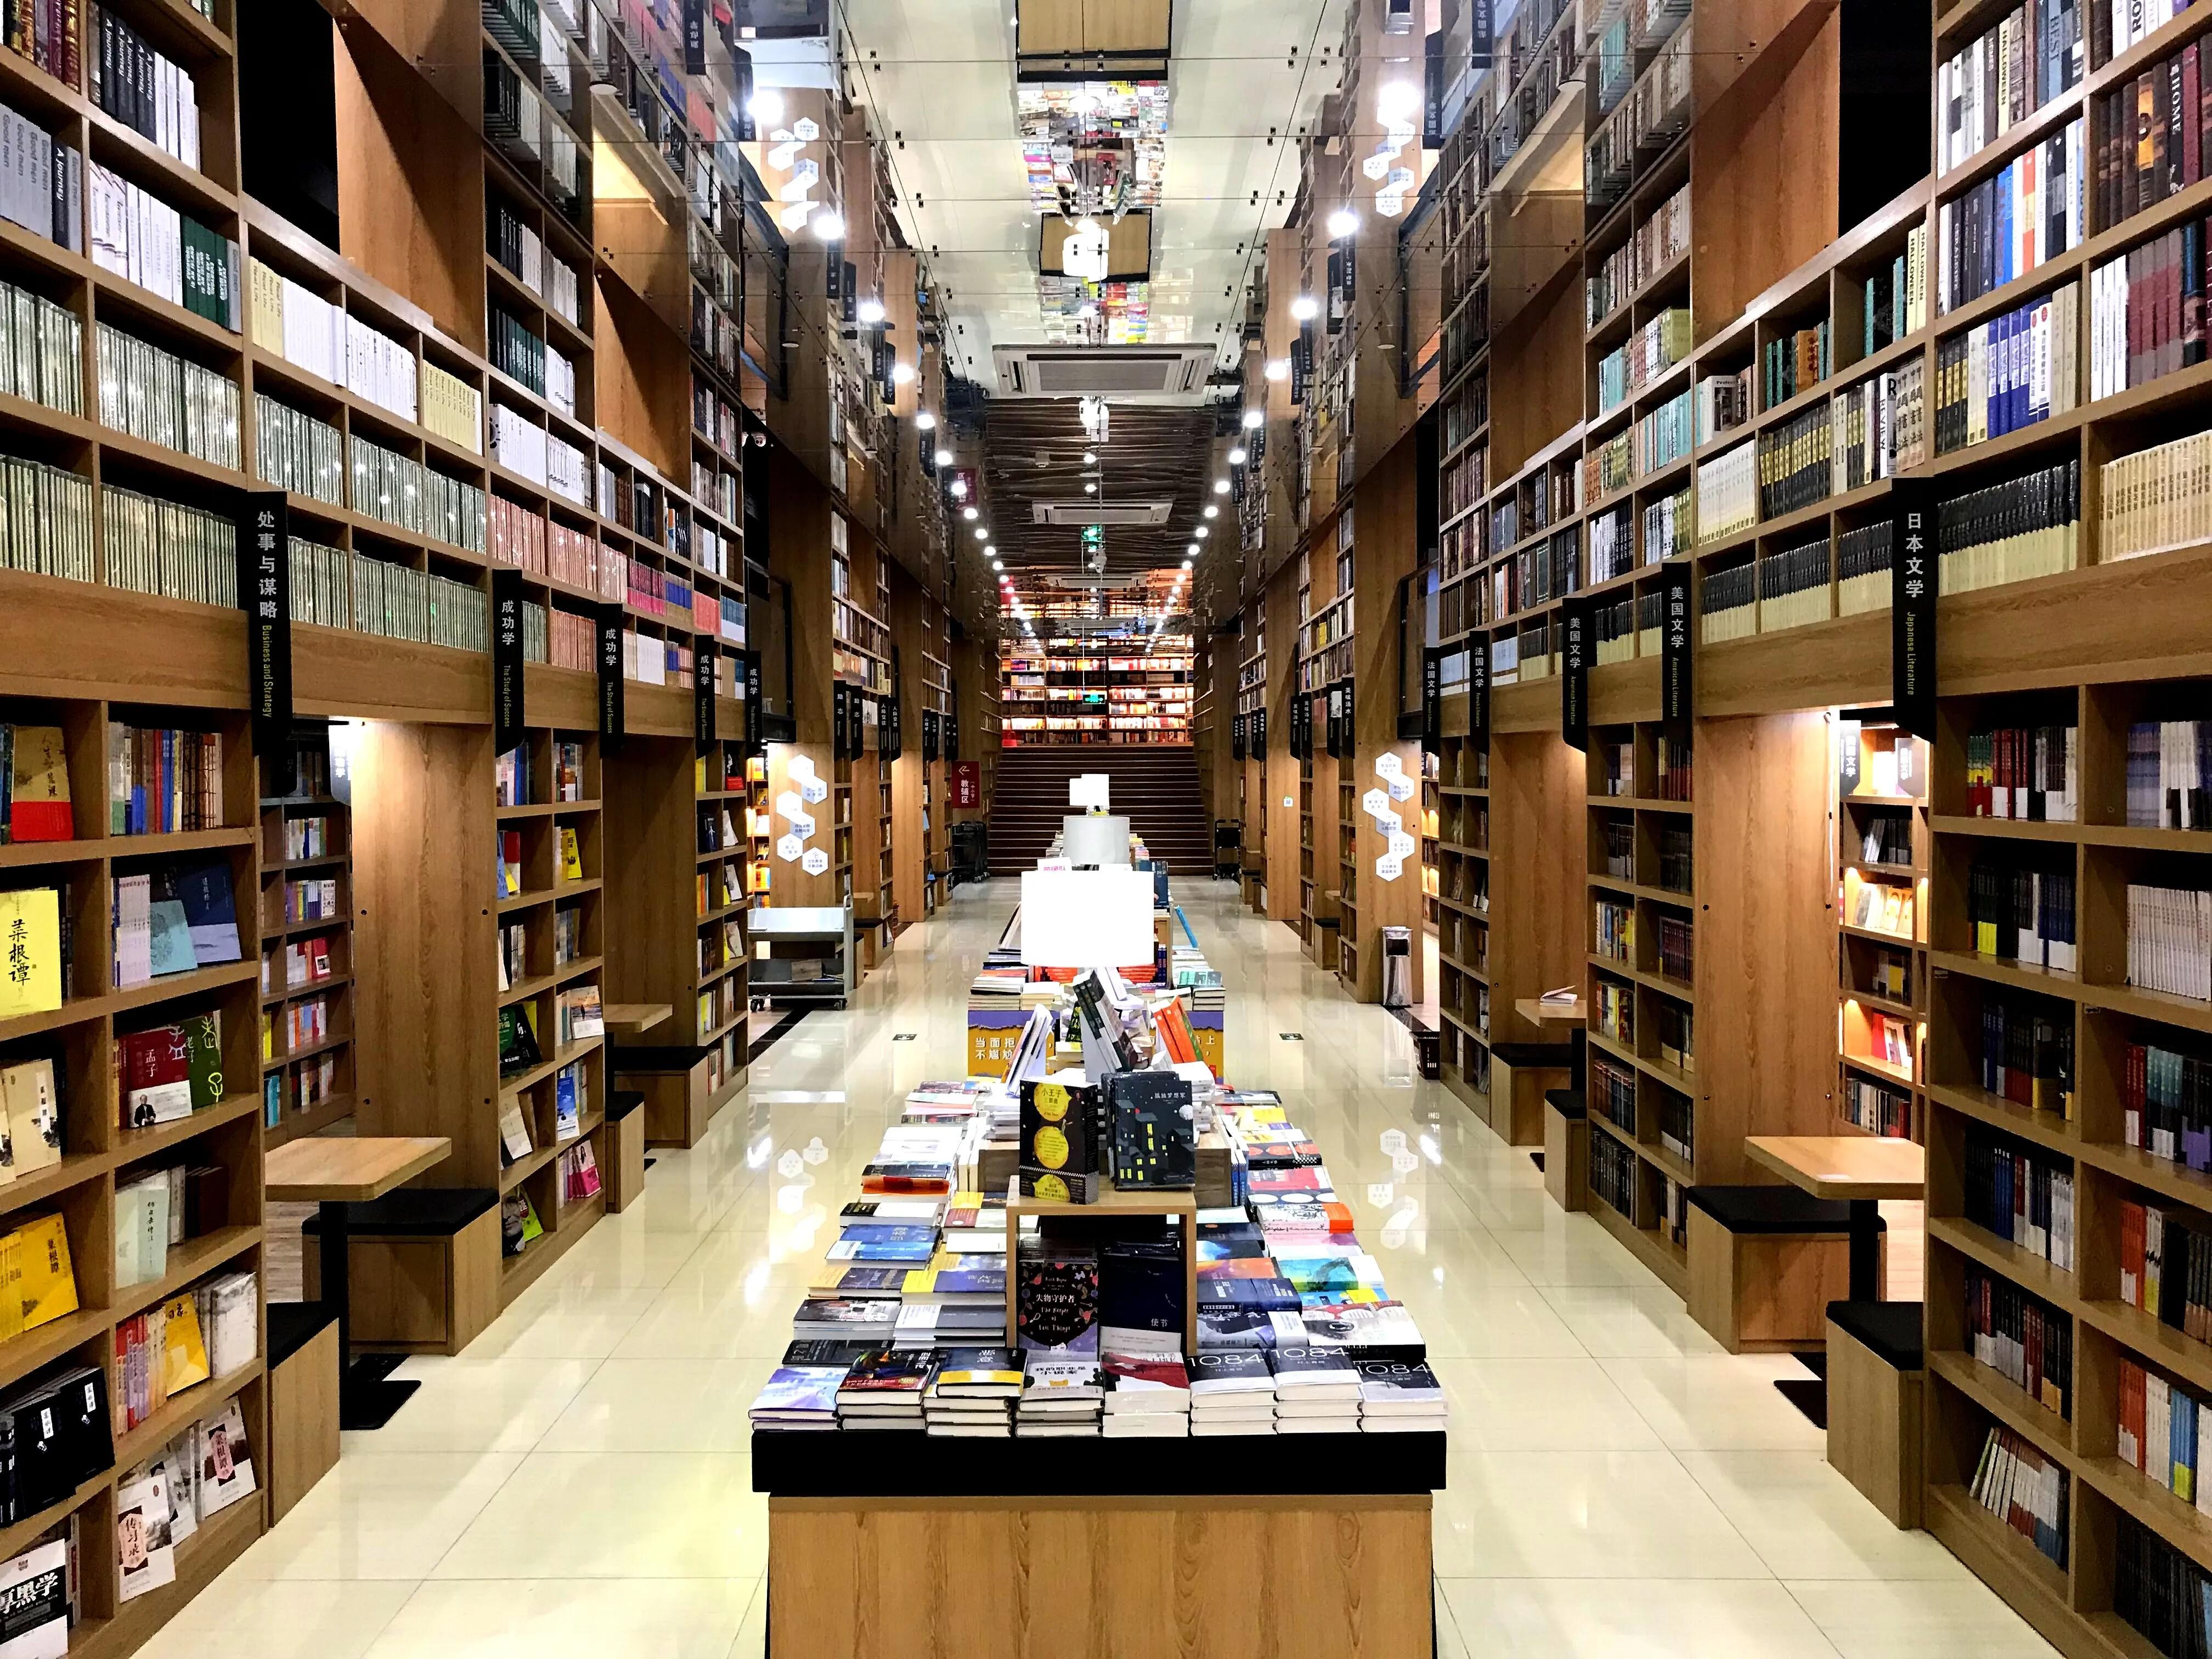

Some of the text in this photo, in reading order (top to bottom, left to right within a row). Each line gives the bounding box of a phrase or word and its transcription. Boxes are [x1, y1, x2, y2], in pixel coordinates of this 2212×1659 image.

[106, 18, 112, 27] A
[119, 26, 125, 35] A
[127, 35, 133, 43] A
[138, 44, 144, 53] A
[147, 53, 153, 61] A
[56, 148, 64, 201] A Journey
[257, 511, 278, 619] 处事与谋略
[1906, 513, 1923, 599] 日本文学
[501, 600, 515, 645] 成功学
[1671, 586, 1684, 648] 美国文学
[606, 628, 617, 666] 成功学
[1570, 617, 1581, 668] 美国文学
[1906, 611, 1916, 696] Japanese Literature
[262, 625, 274, 718] Business and Strategy
[700, 654, 709, 685] 成功学
[1475, 647, 1483, 687] 法国文学
[749, 668, 758, 695] 成功学
[8, 919, 31, 986] 菜根谭
[975, 1037, 1015, 1048] 当面拒
[145, 1049, 157, 1077] 孟子
[1042, 1088, 1062, 1097] 小王子
[1036, 1294, 1075, 1304] 失物守护者
[1052, 1324, 1070, 1333] Things
[1187, 1353, 1265, 1367] 1Q84
[1270, 1346, 1350, 1358] 1Q84
[1356, 1363, 1431, 1375] 1Q84
